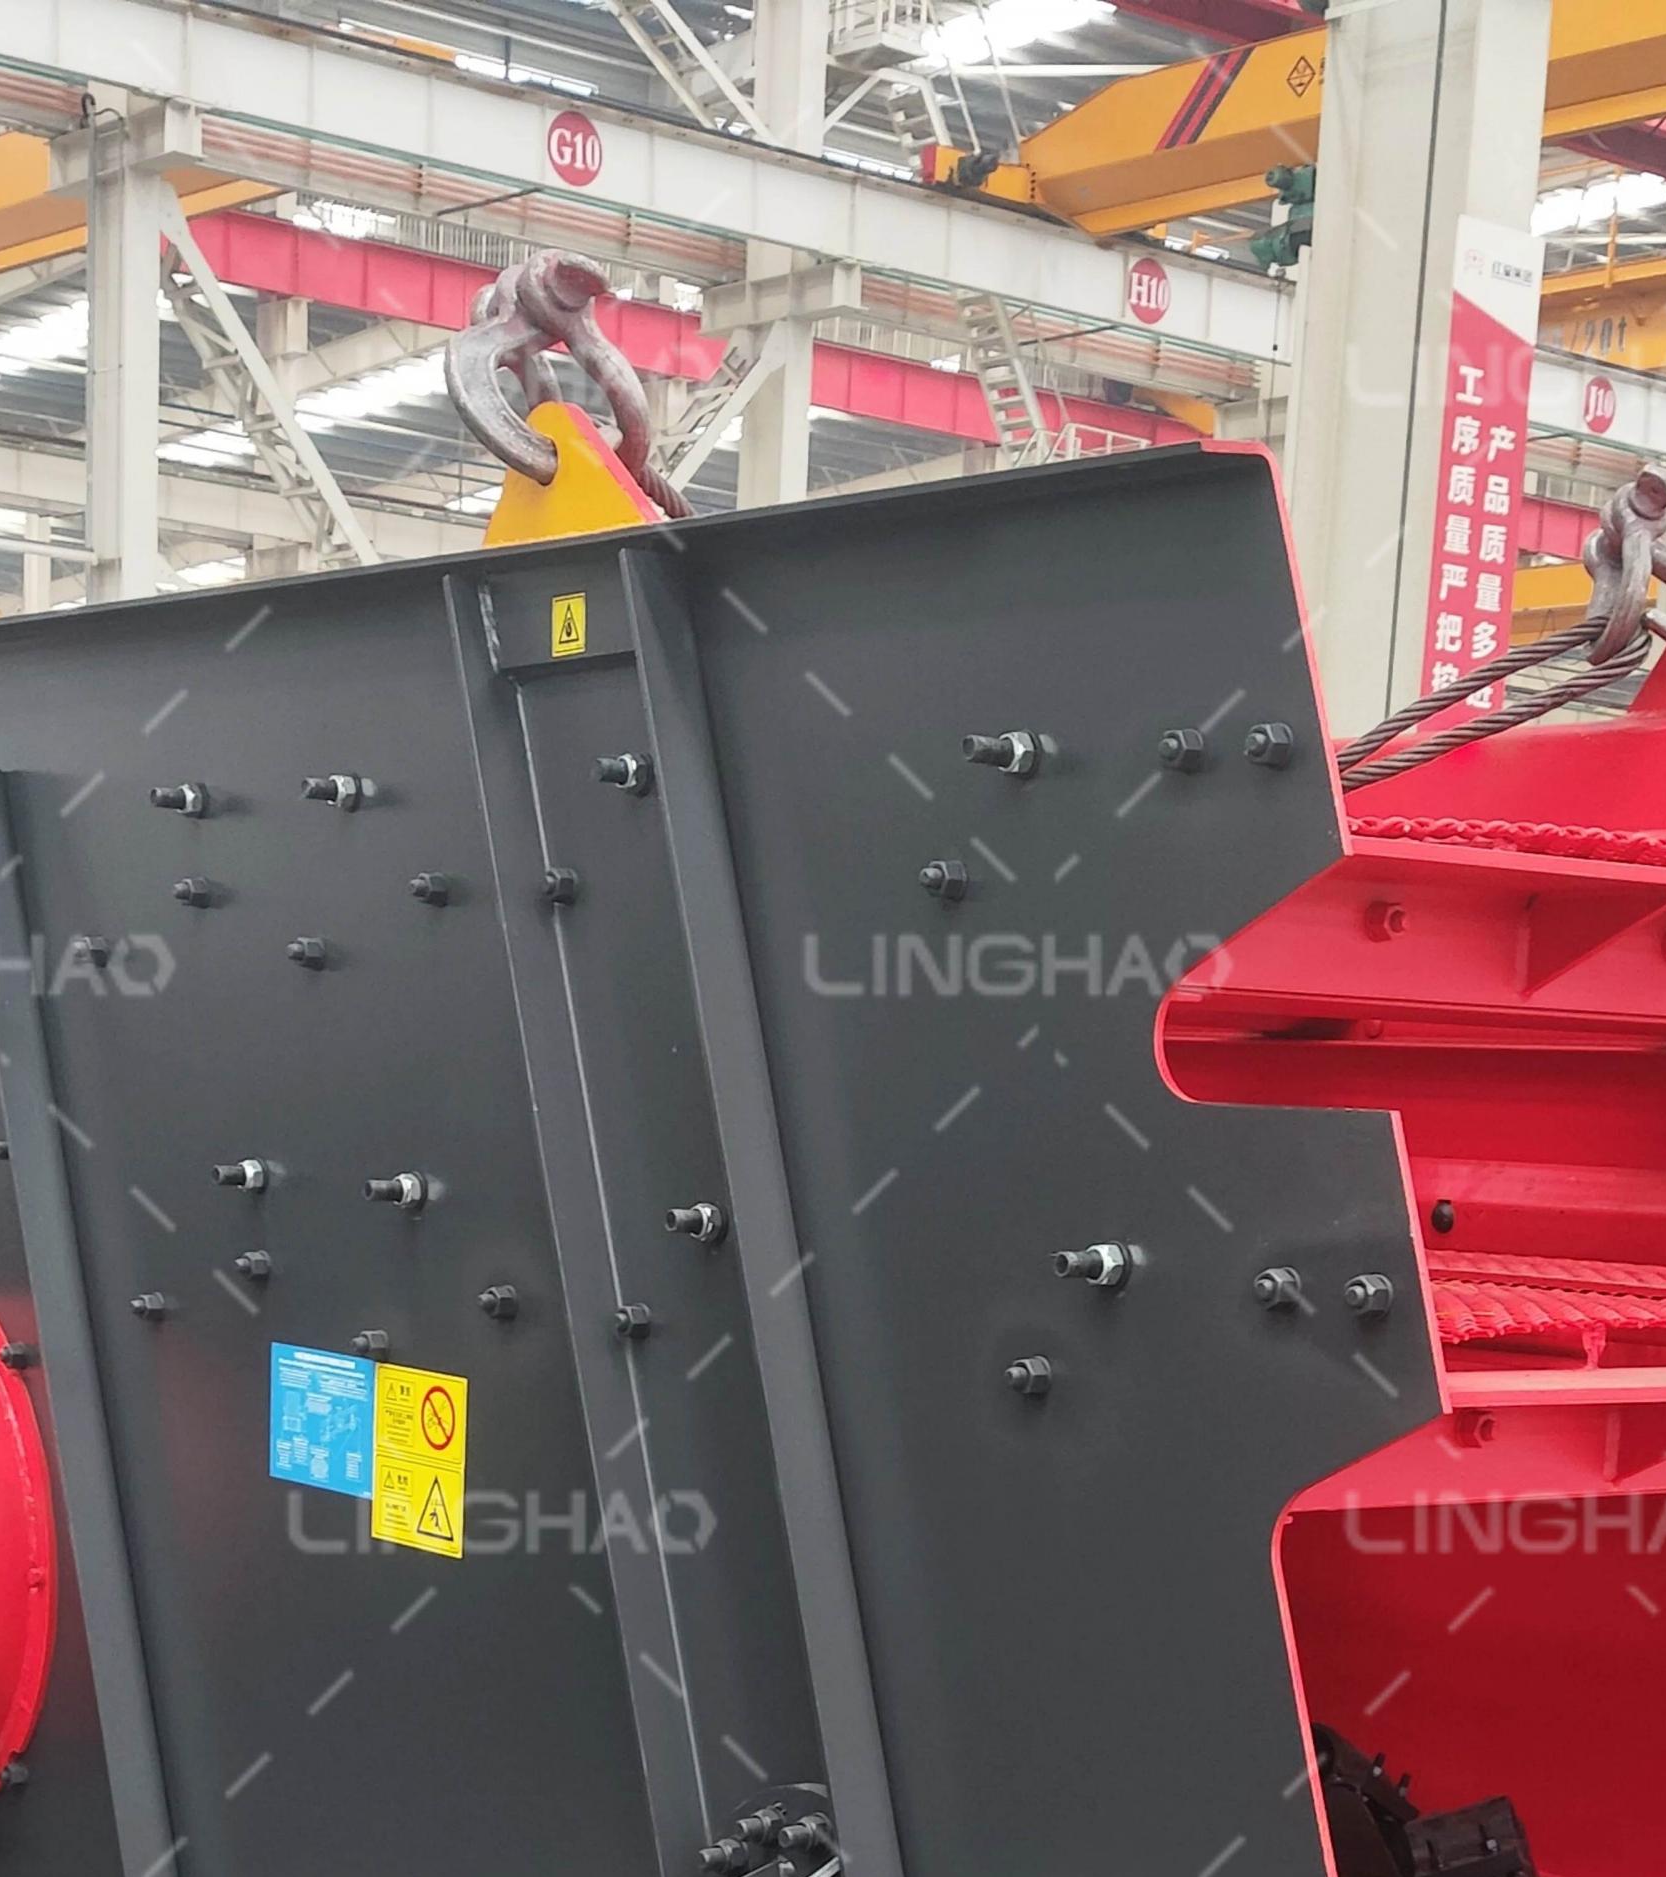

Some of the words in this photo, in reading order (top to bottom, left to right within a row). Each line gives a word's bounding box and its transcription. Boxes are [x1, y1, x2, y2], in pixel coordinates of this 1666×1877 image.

[548, 132, 602, 172] G10
[1129, 274, 1170, 312] H10
[1585, 385, 1615, 422] J10
